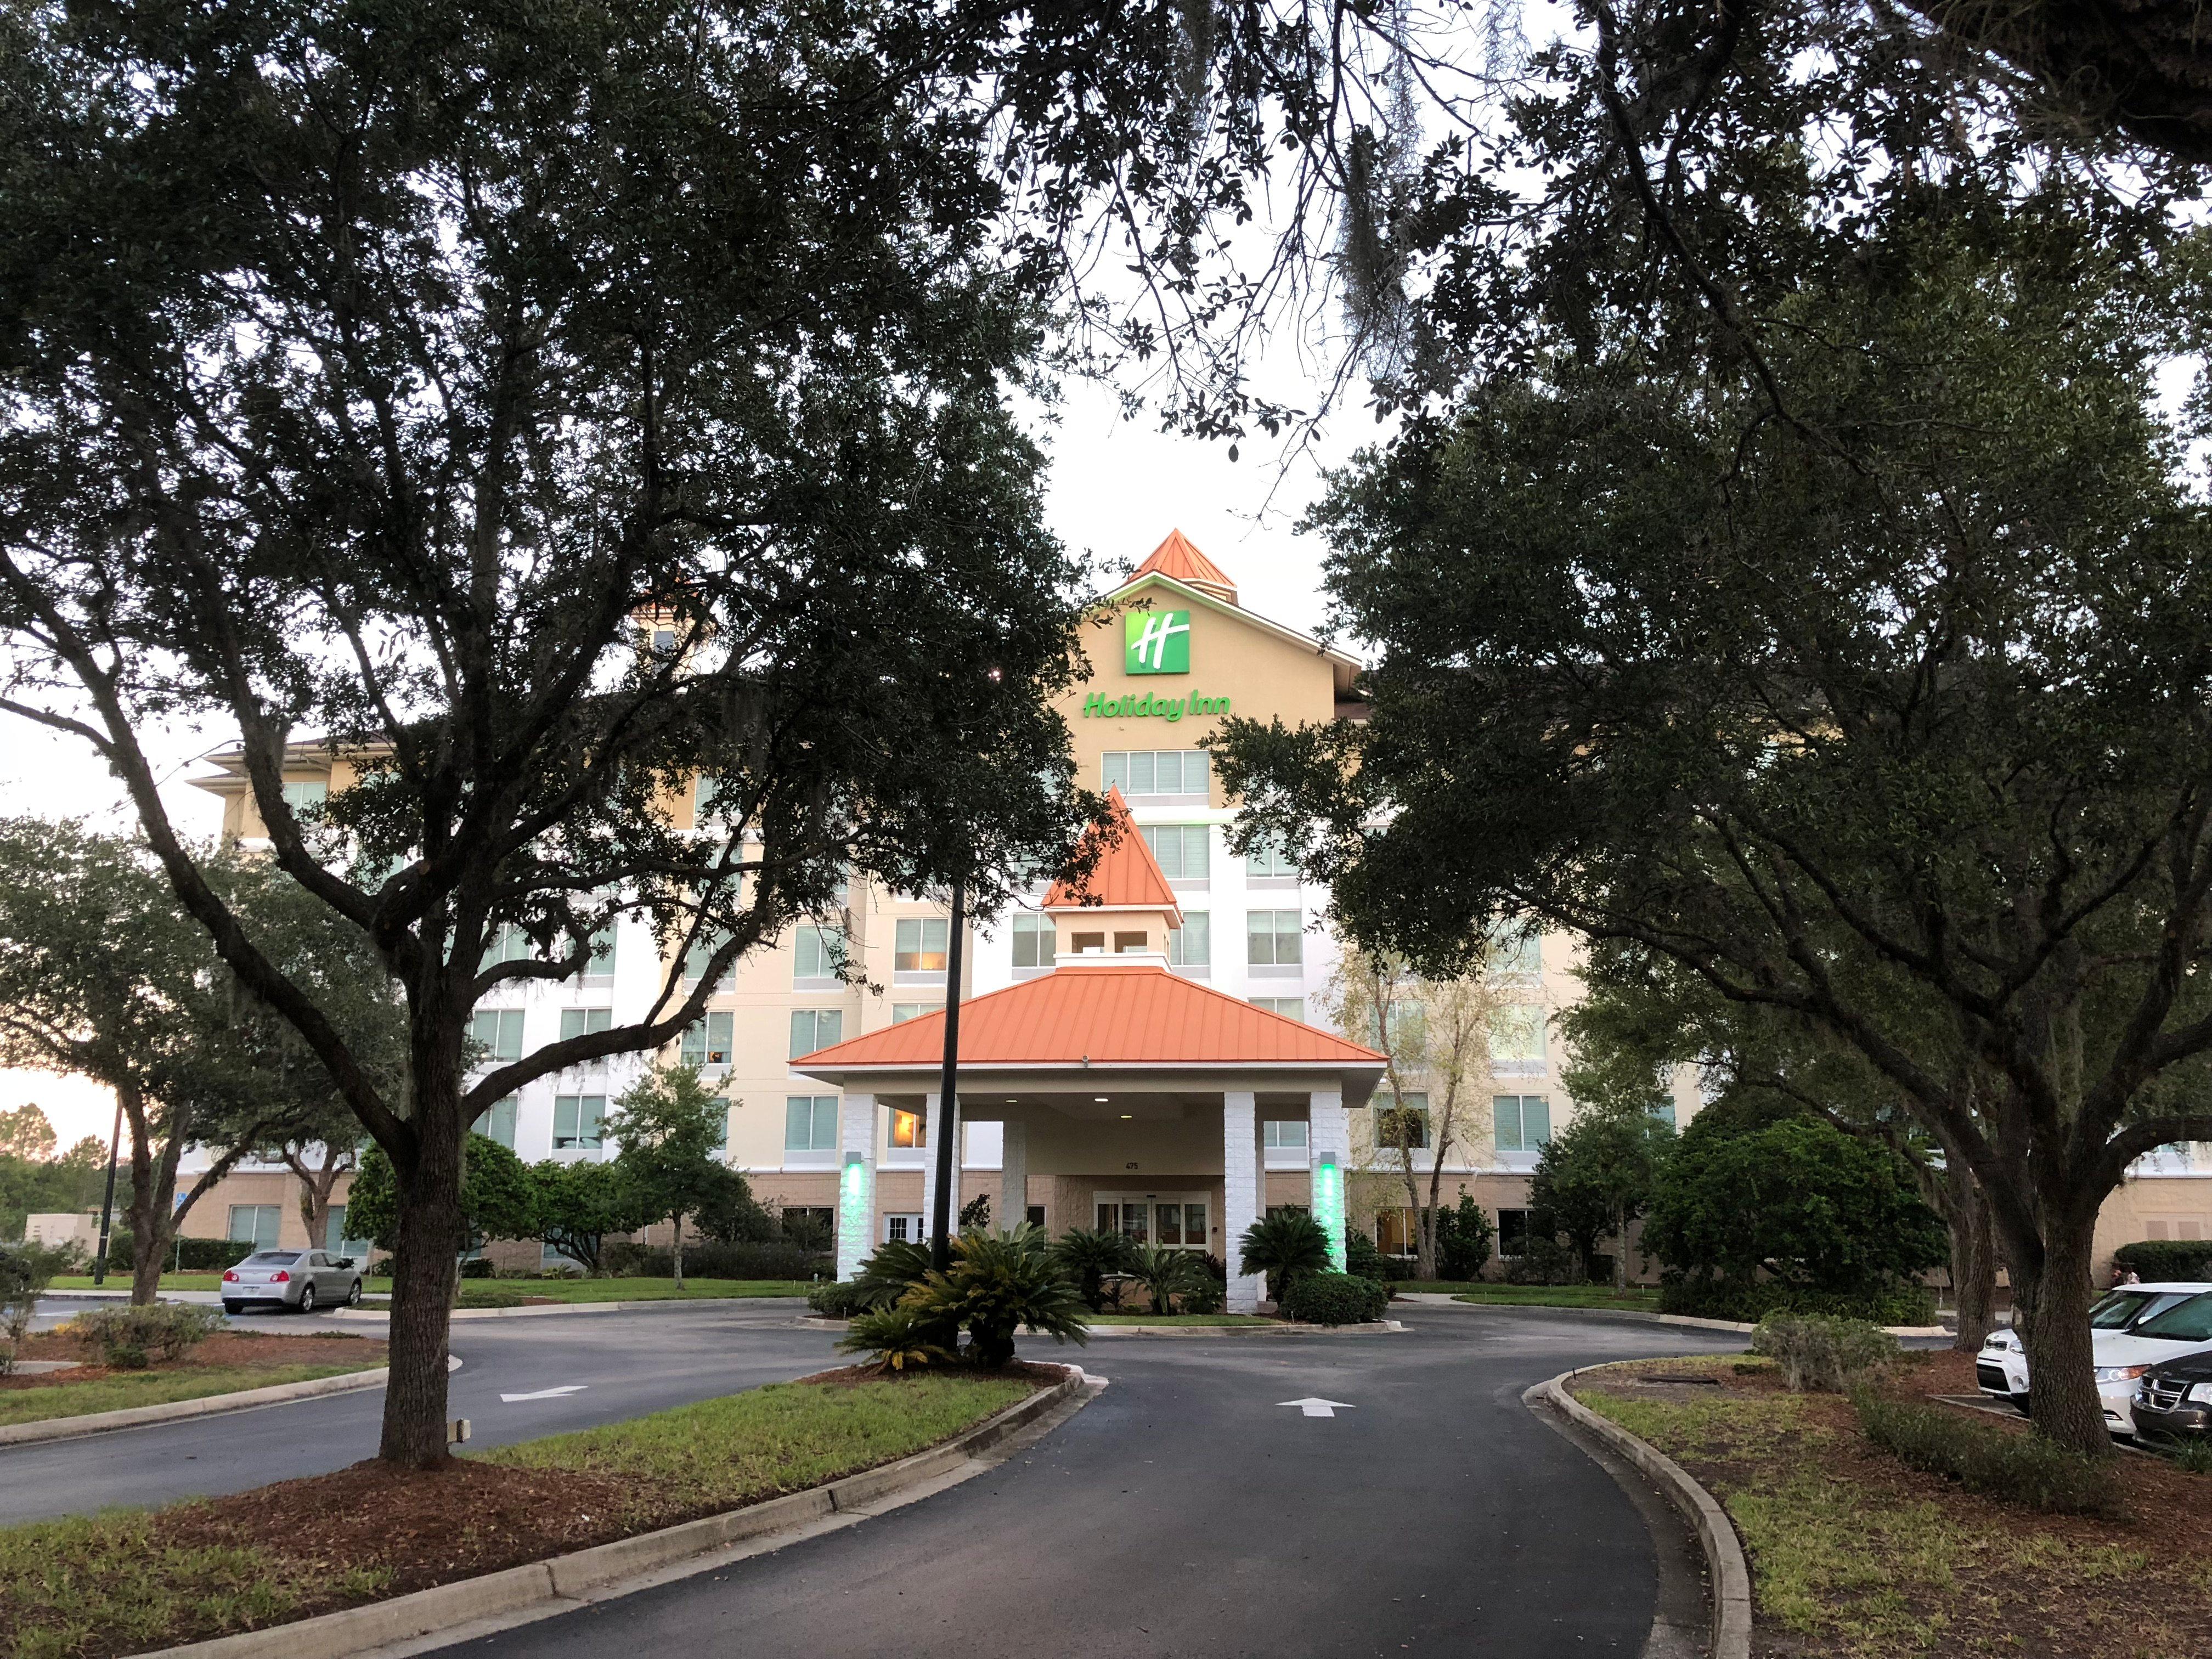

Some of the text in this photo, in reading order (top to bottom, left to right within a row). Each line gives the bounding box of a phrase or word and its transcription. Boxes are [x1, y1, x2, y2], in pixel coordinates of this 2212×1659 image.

[1131, 613, 1189, 669] H
[1084, 689, 1230, 722] Holiday Inn
